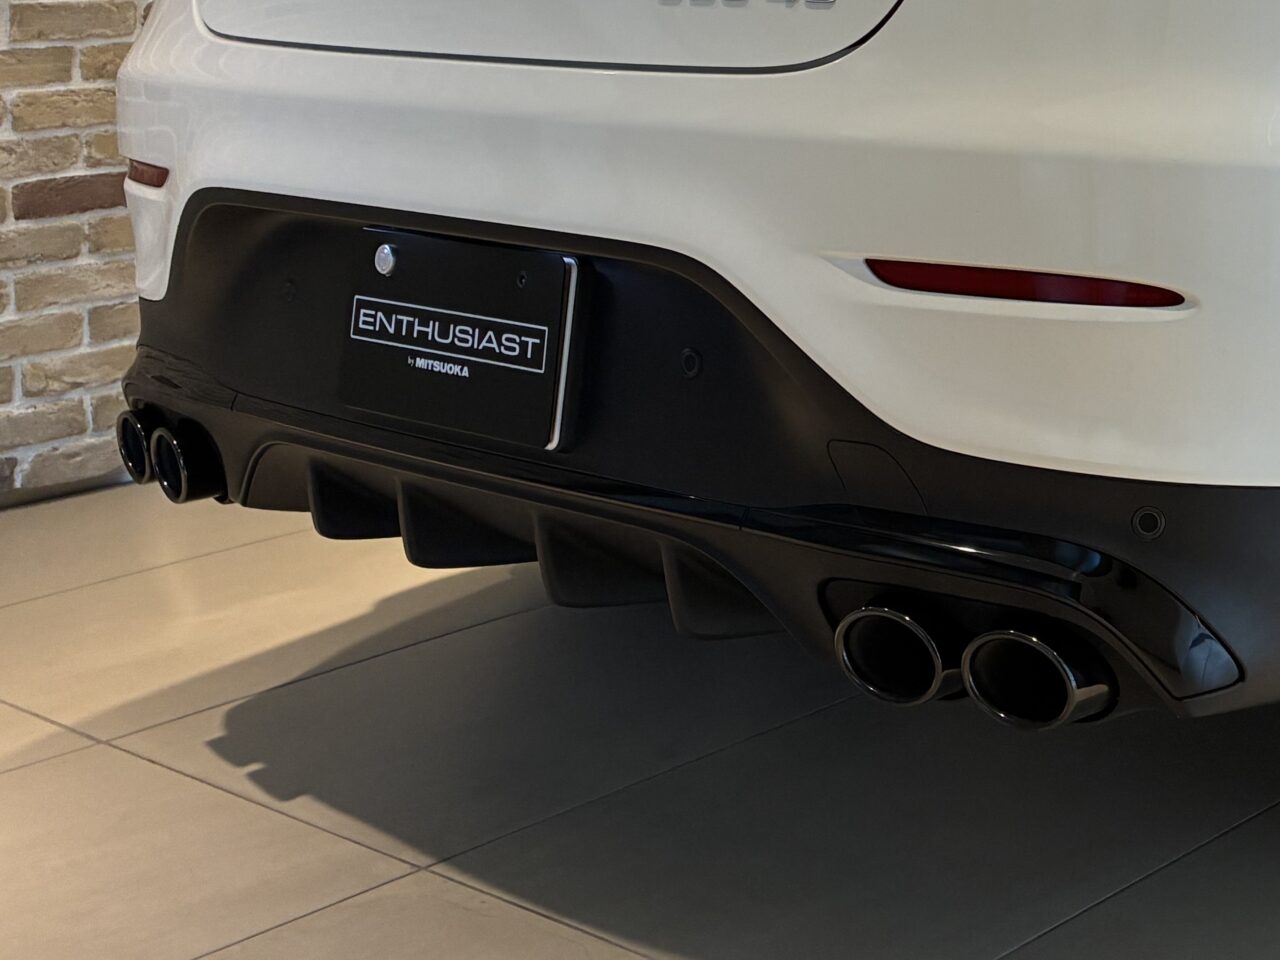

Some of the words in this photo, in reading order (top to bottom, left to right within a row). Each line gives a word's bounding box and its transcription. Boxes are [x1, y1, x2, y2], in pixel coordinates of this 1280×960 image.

[358, 308, 541, 359] ENTHUSIAST
[407, 355, 415, 367] by
[415, 357, 470, 377] MITSUOKA
